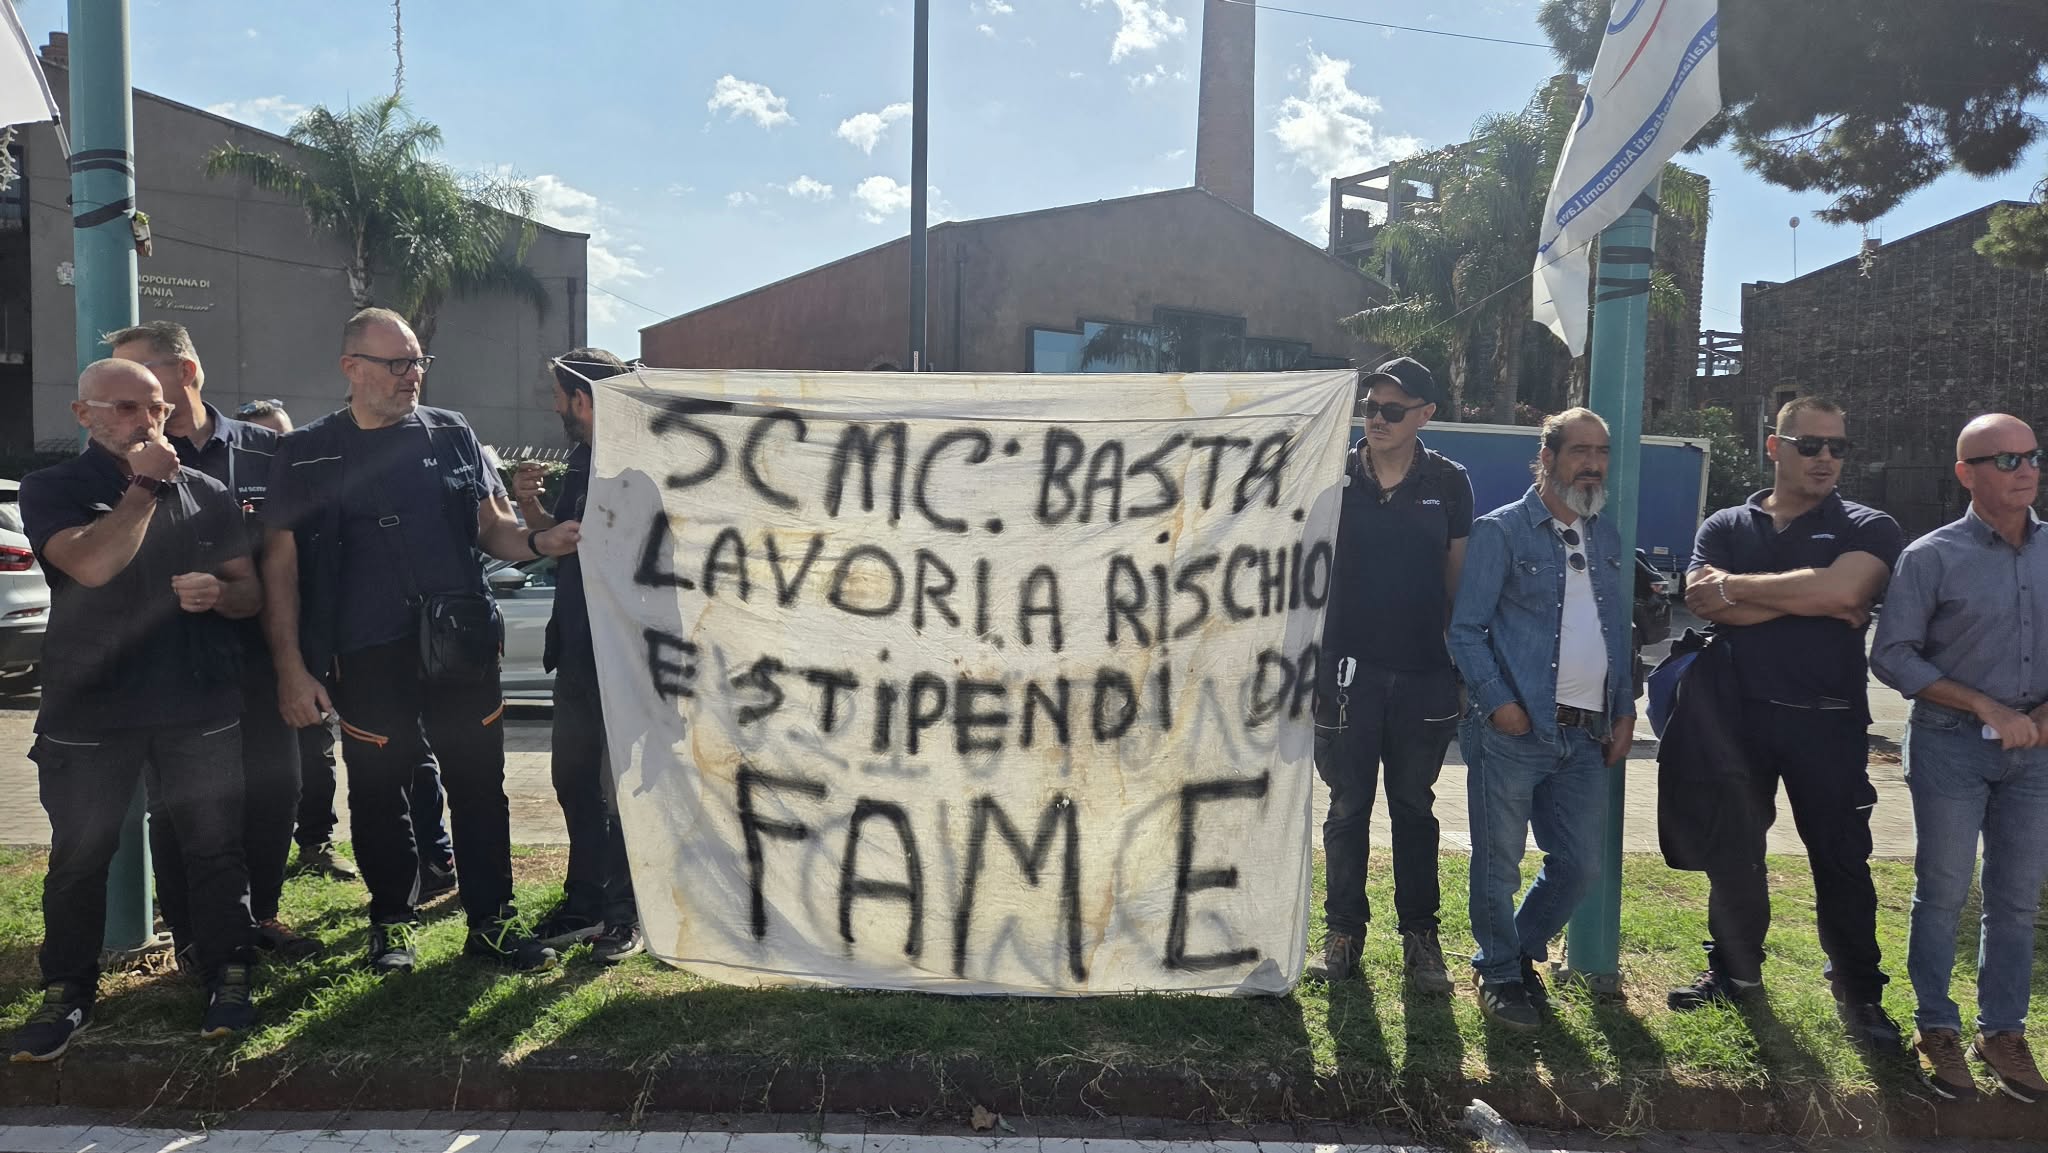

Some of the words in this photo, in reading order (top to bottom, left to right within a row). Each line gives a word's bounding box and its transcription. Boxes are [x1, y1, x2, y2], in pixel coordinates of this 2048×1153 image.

[139, 274, 198, 288] OPOLITANA
[200, 280, 210, 288] DI
[139, 286, 173, 298] TANIA
[634, 511, 994, 638] LAVORI
[1018, 564, 1063, 652] A
[643, 627, 698, 703] E
[737, 768, 1270, 983] FAME
